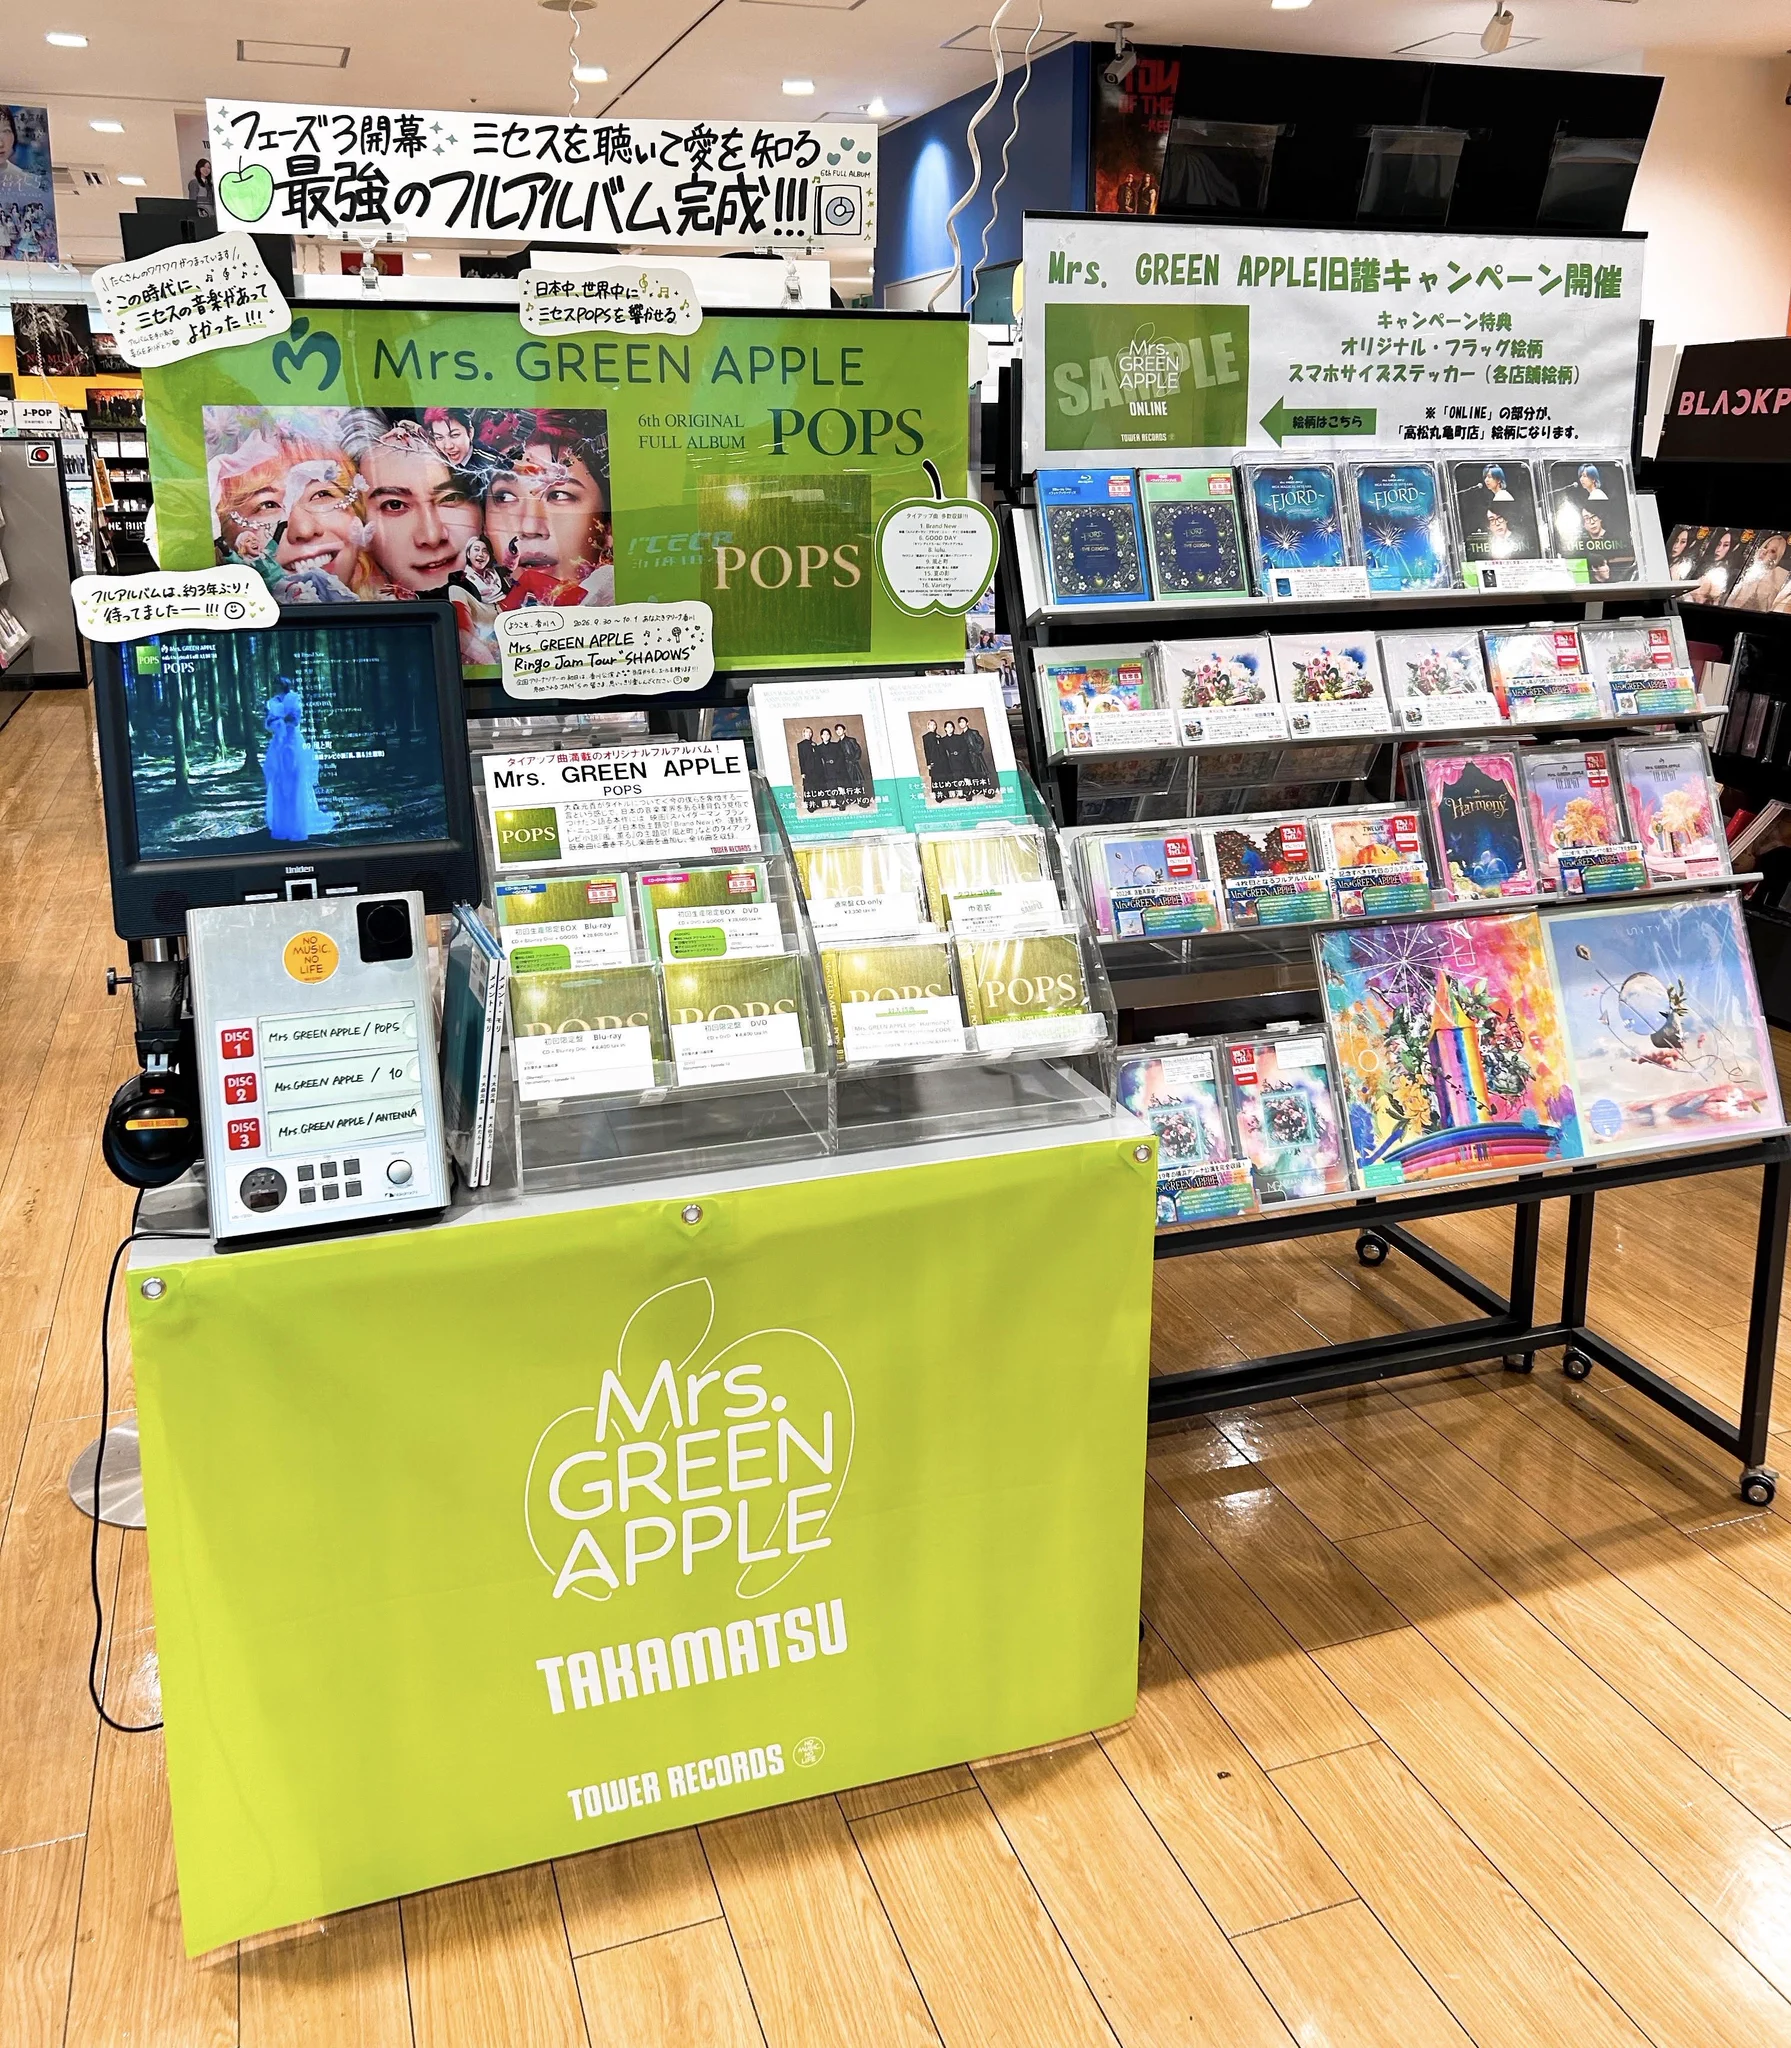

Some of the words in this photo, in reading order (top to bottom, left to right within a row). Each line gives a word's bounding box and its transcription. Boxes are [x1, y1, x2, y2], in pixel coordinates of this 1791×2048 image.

[231, 110, 427, 158] フェーズ3開幕
[848, 170, 870, 178] ALBUM
[273, 154, 808, 237] 最強のフルアルバム完成!!!
[1048, 250, 1107, 288] Mrs.
[1136, 252, 1220, 286] GREEN
[116, 279, 202, 310] この時代に、
[536, 280, 639, 299] 日本中、世界中に
[136, 284, 268, 329] ミセスの音楽があって
[539, 304, 677, 325] ミセスPOPSを響かせる
[1377, 310, 1512, 332] キャンペーン特典
[1129, 339, 1170, 357] Mrs.
[1341, 337, 1544, 360] オリジナル・フラッグ絵柄
[374, 339, 495, 382] Mrs.
[515, 341, 691, 385] GREEN
[711, 345, 865, 387] APPLE
[1119, 356, 1179, 372] GREEN
[1053, 331, 1240, 417] SAMPLE
[1119, 372, 1179, 389] APPLE
[23, 408, 52, 417] J-POP
[1129, 401, 1168, 416] ONLINE
[638, 411, 662, 429] 6th
[665, 412, 746, 429] ORIGINAL
[1292, 416, 1363, 429] 絵柄はこちら
[767, 407, 924, 457] POPS
[1121, 433, 1139, 443] TOWER
[1141, 433, 1167, 442] RECORDS
[1398, 424, 1580, 441] 「高松丸亀町店」絵柄になります。
[638, 434, 683, 450] FULL
[687, 434, 746, 450] ALBUM
[714, 544, 862, 591] POPS
[91, 582, 250, 603] フルアルバムは、約3年ぶり!
[931, 582, 951, 590] Variety
[540, 636, 584, 651] GREEN
[589, 632, 635, 648] APPLE
[138, 655, 160, 665] POPS
[163, 662, 195, 674] POPS
[514, 657, 551, 674] Ringo
[555, 654, 584, 670] Jam
[587, 652, 617, 668] Tour
[507, 745, 720, 767] タイアップ曲満載のオリジナルフルアルバム!
[493, 771, 546, 789] Mrs.
[561, 762, 648, 784] GREEN
[663, 756, 741, 778] APPLE
[603, 784, 643, 797] POPS
[1444, 793, 1508, 820] Harmony
[501, 826, 557, 844] POPS
[1351, 877, 1376, 888] GREEN
[1245, 887, 1271, 898] GREEN
[742, 907, 759, 915] DVD
[867, 898, 883, 908] only
[1130, 898, 1156, 909] GREEN
[584, 922, 612, 931] Blu-ray
[303, 936, 318, 945] NO
[304, 955, 320, 964] NO
[300, 963, 324, 975] LIFE
[985, 974, 1077, 1008] POPS
[486, 975, 496, 1033] メメント・モリ
[496, 975, 506, 1033] メメント・モリ
[292, 1029, 328, 1040] GREEN
[329, 1026, 361, 1038] APPLE
[374, 1022, 400, 1034] POPS
[750, 1020, 768, 1028] DVD
[224, 1031, 250, 1043] DISC
[593, 1033, 622, 1042] Blu-ray
[234, 1044, 242, 1056] 1
[228, 1075, 253, 1088] DISC
[293, 1077, 329, 1090] GREEN
[332, 1072, 364, 1086] APPLE
[388, 1068, 403, 1079] 10
[236, 1088, 247, 1102] 2
[231, 1120, 257, 1133] DISC
[300, 1120, 335, 1134] GREEN
[336, 1115, 366, 1128] APPLE
[375, 1106, 418, 1122] ANTENNA
[239, 1134, 250, 1148] 3
[595, 1359, 788, 1443] Mrs.
[549, 1411, 833, 1521] GREEN
[551, 1482, 832, 1600] APPLE
[535, 1597, 848, 1716] TAKAMATSU
[567, 1771, 662, 1822] TOWER
[667, 1743, 785, 1799] RECORDS
